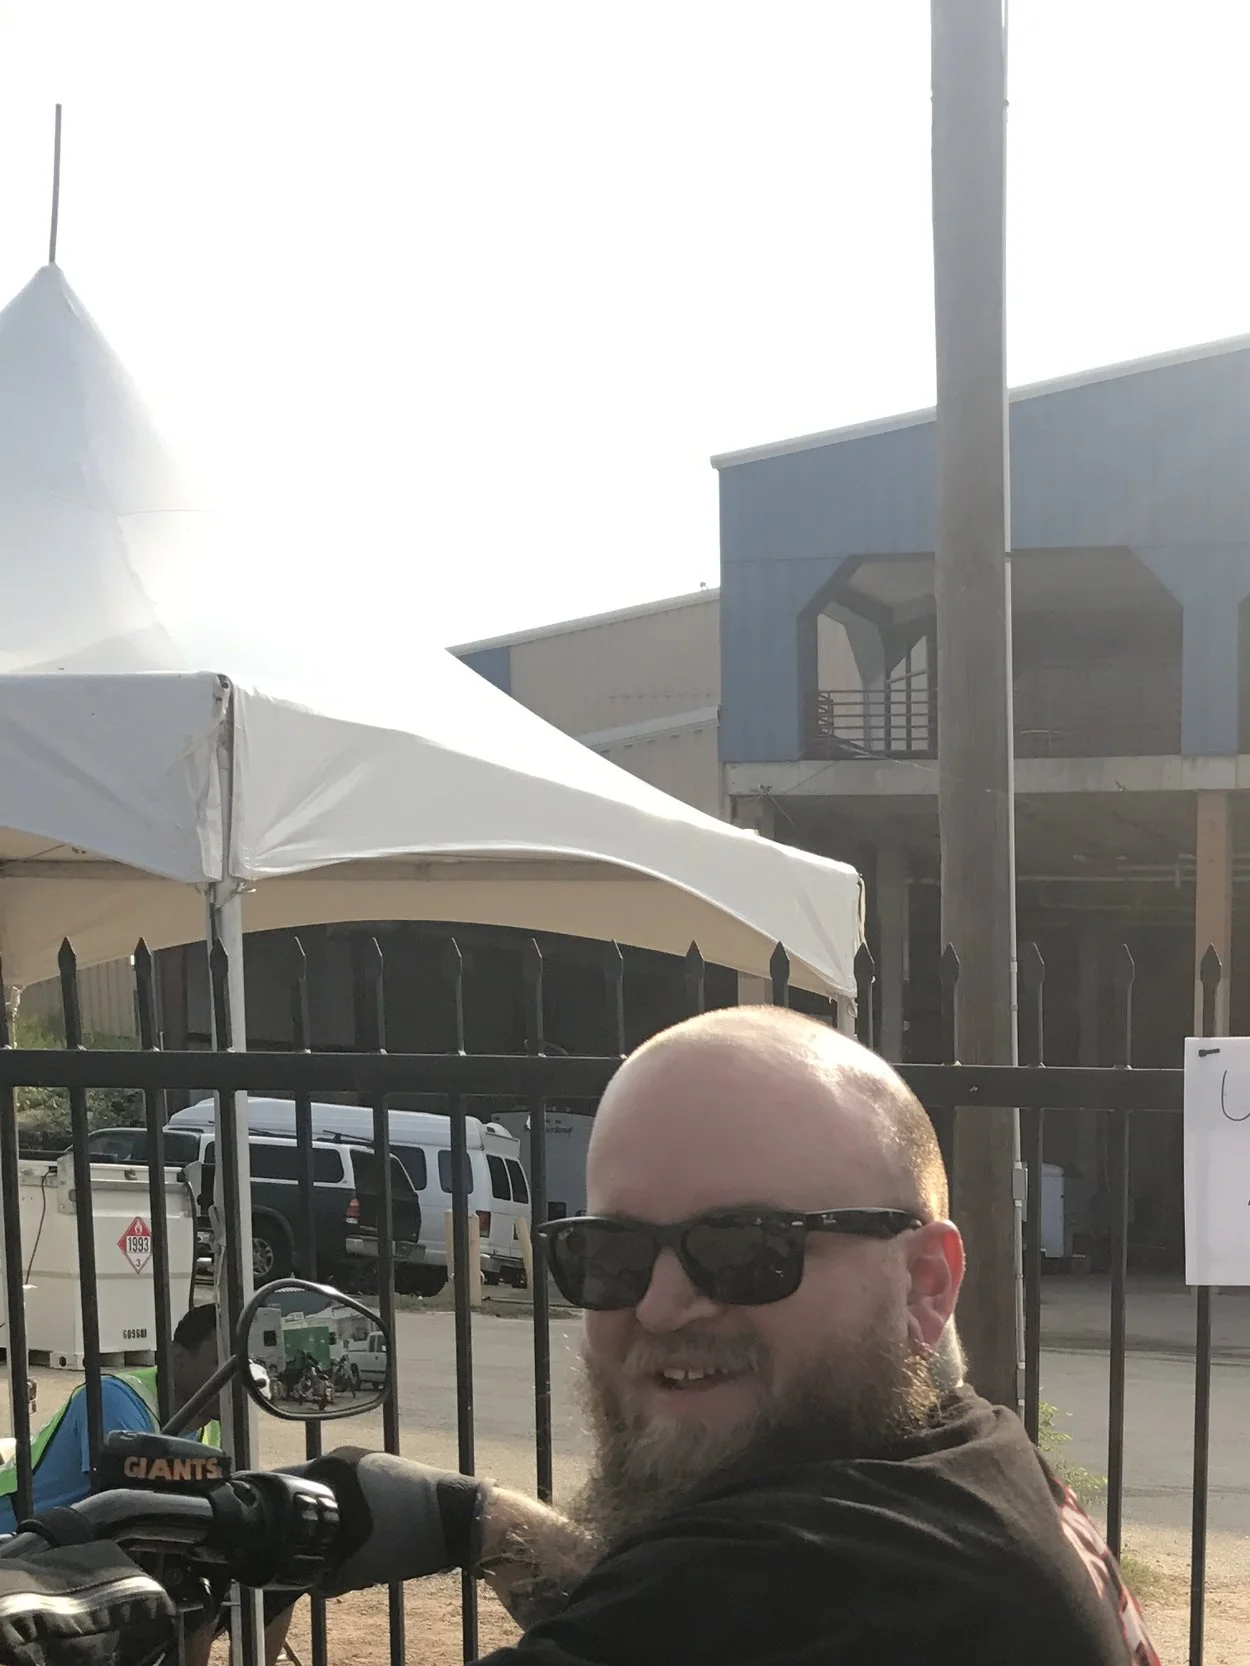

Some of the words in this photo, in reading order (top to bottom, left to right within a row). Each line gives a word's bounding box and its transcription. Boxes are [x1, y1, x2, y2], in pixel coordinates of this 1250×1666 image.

[127, 1236, 149, 1252] 1993
[135, 1258, 141, 1267] 3
[124, 1456, 223, 1481] GIANTS
